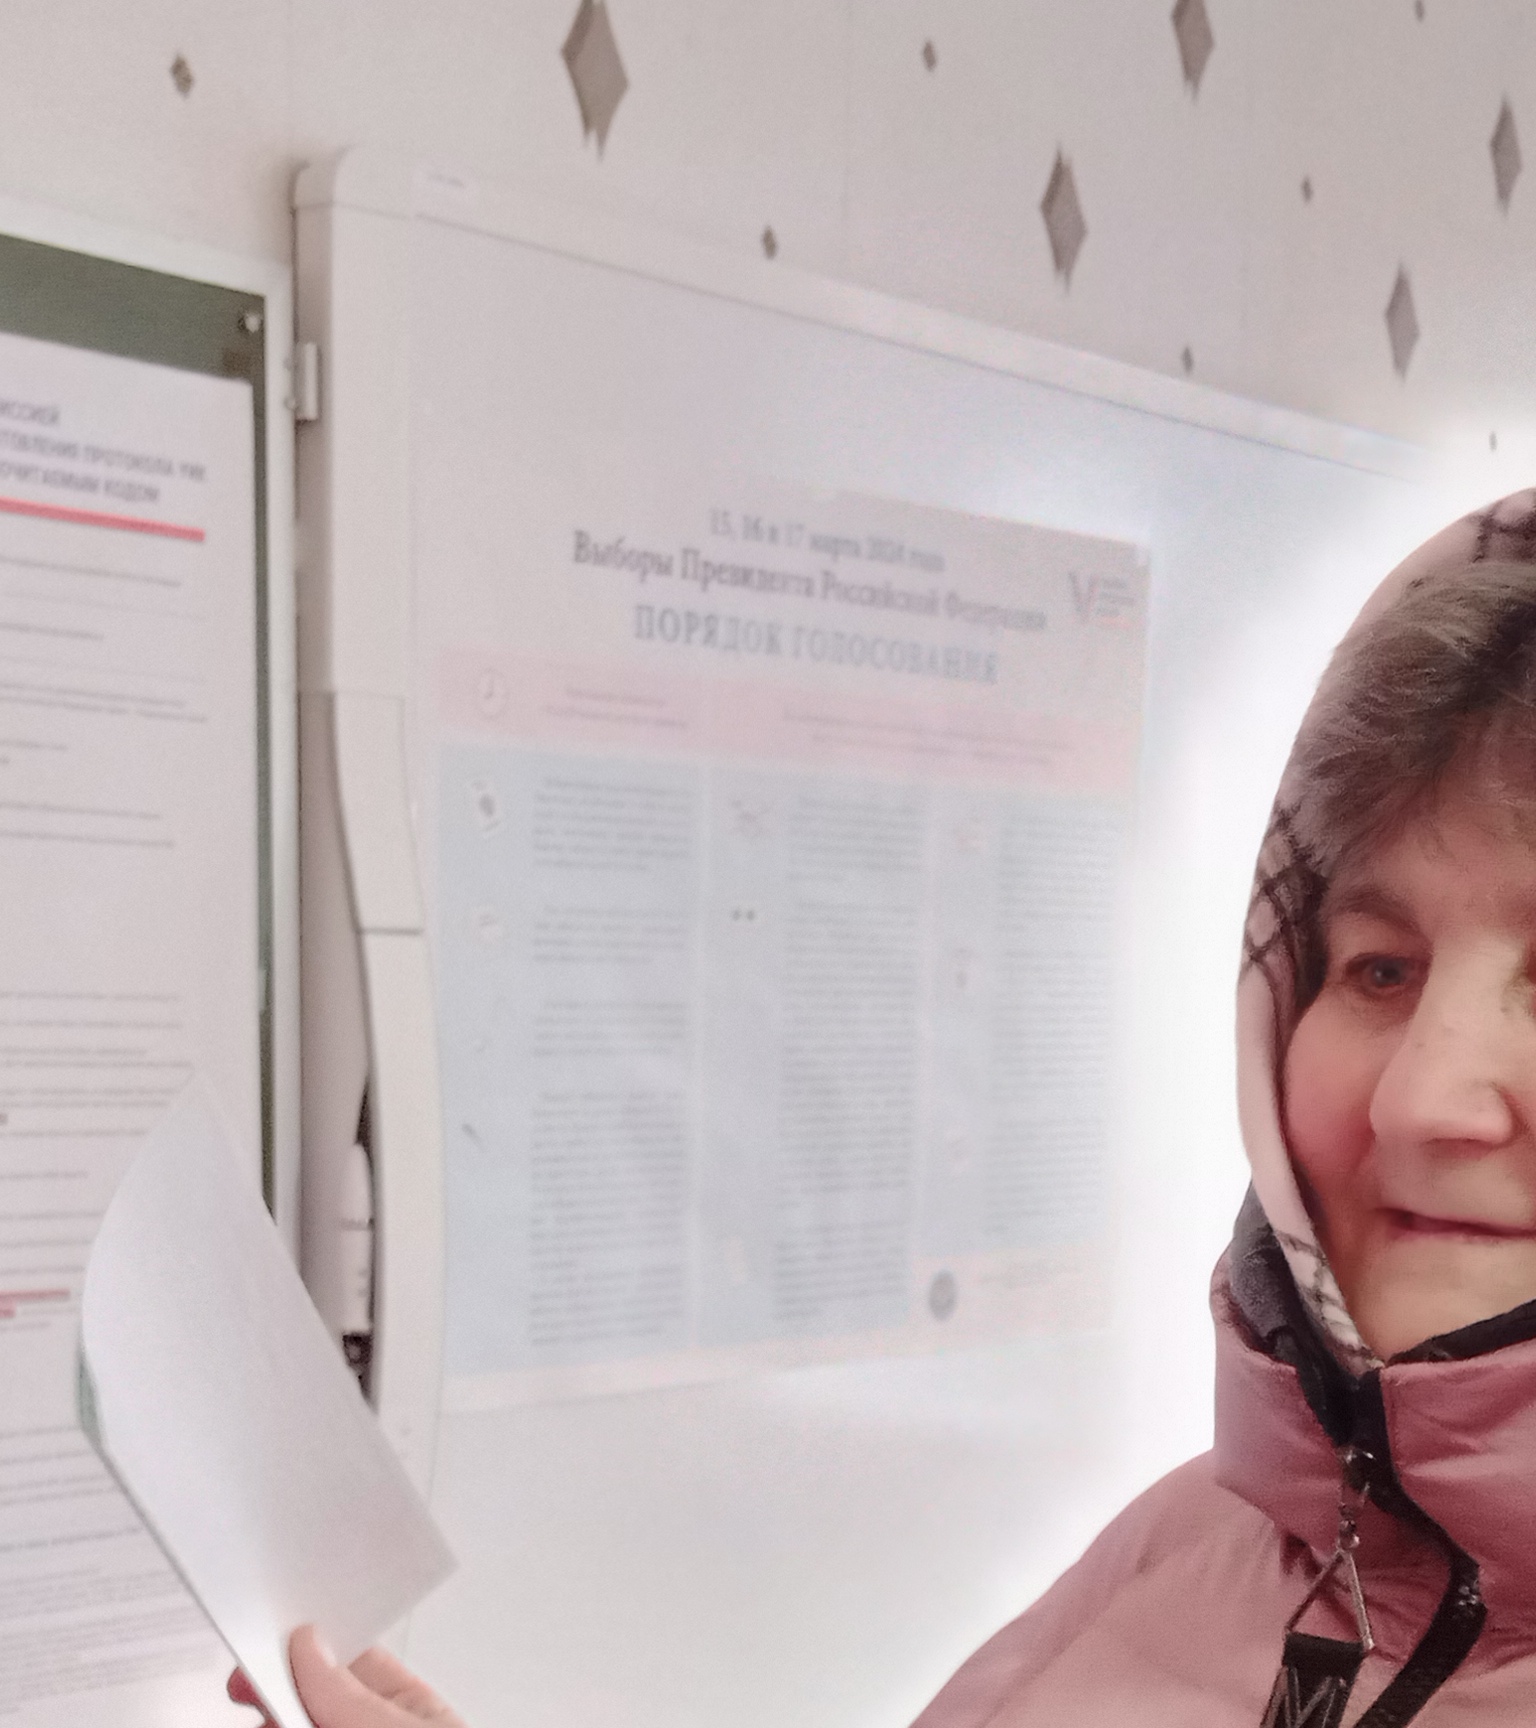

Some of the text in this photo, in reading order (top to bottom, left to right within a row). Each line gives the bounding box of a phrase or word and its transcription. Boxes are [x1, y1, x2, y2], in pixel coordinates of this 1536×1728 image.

[573, 529, 673, 584] Выборы
[680, 547, 814, 598] Президента
[820, 568, 940, 618] Российской
[634, 603, 999, 686] ПОРЯДОК ГОЛОСОВАНИЯ
